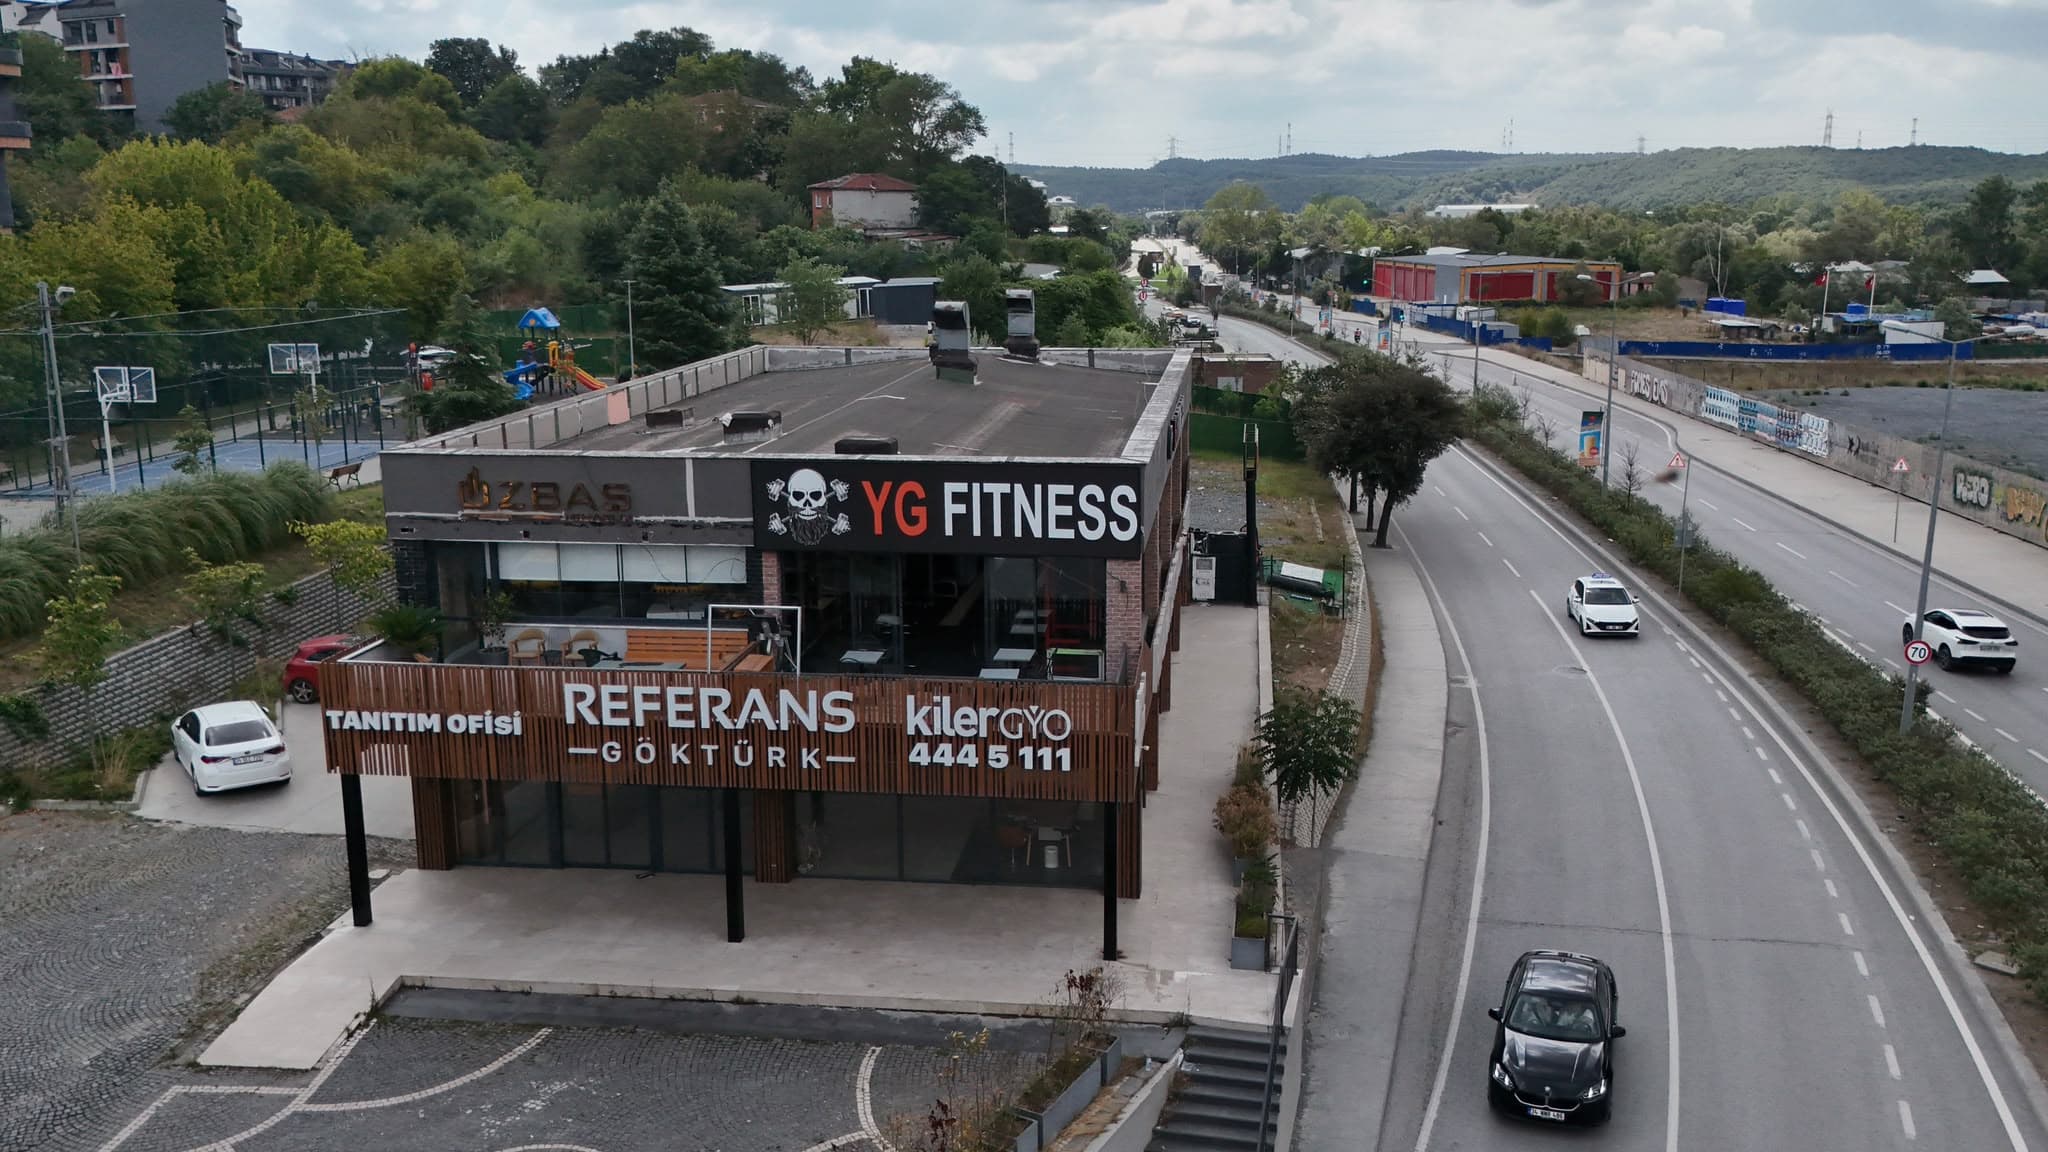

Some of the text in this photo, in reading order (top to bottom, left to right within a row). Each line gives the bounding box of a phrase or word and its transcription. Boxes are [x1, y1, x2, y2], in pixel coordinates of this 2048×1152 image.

[861, 480, 1138, 542] YG FITNESS
[1911, 646, 1927, 659] 70
[325, 709, 441, 735] TANITIM
[563, 682, 856, 733] REFERANS
[601, 737, 822, 770] GÖKTÜRK
[908, 742, 1072, 772] 444 5 111
